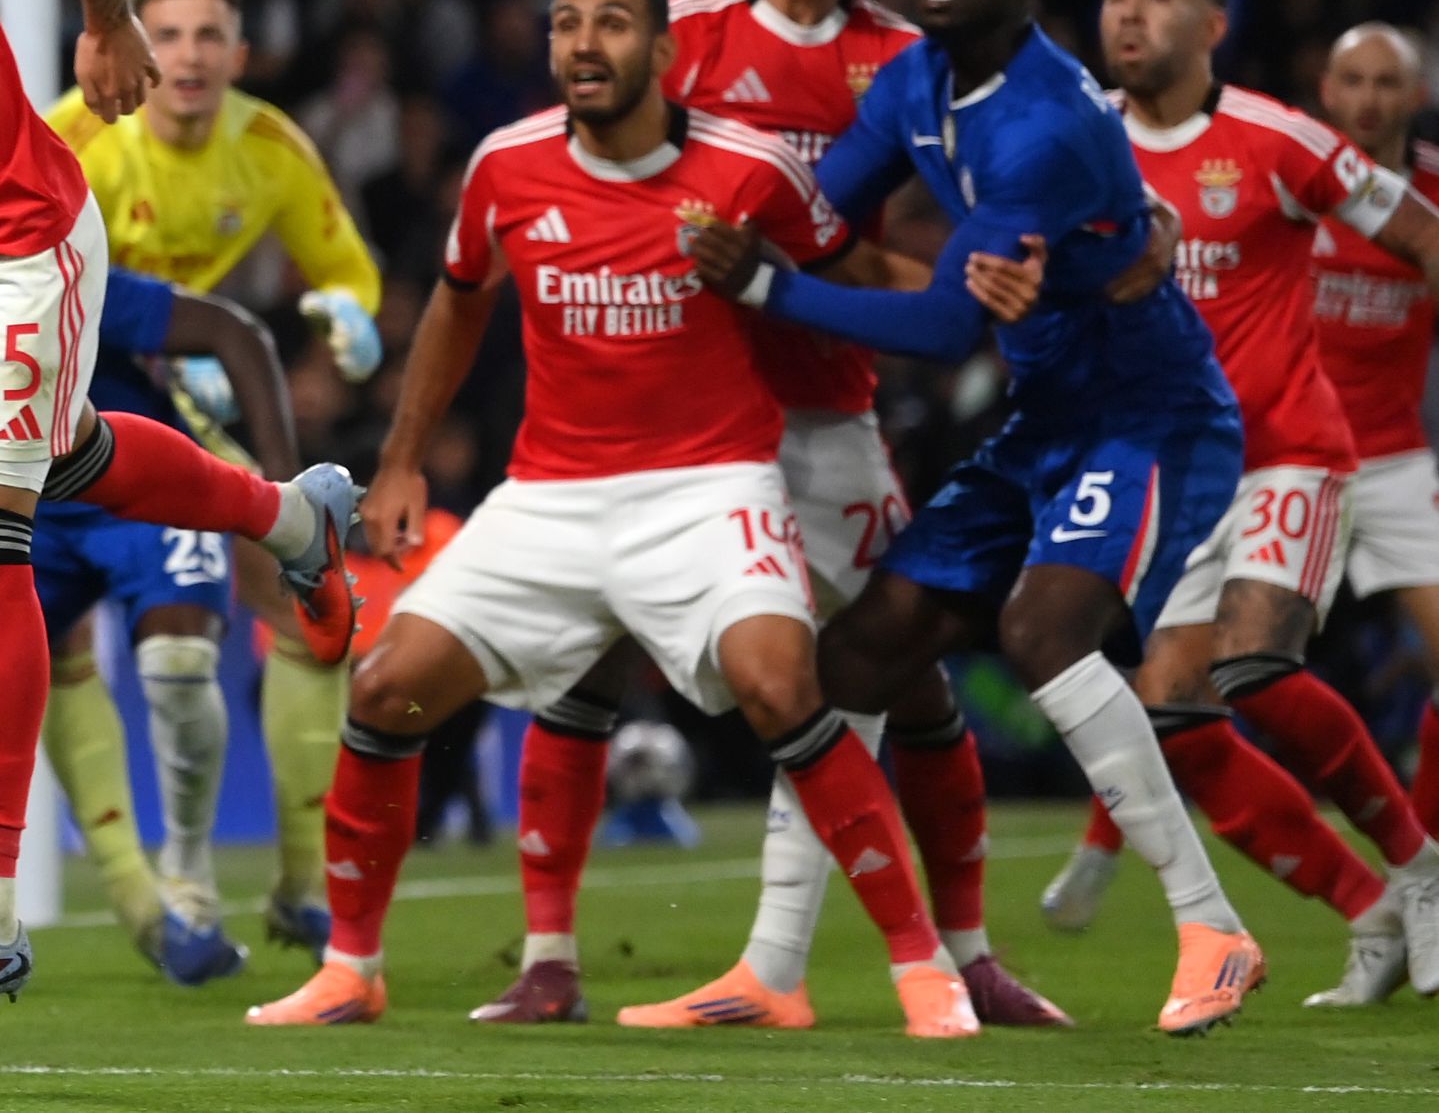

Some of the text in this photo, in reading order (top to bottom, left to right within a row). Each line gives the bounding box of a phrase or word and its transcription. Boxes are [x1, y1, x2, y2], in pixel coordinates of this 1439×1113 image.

[536, 263, 703, 305] Emirates
[563, 302, 683, 336] FLY BETTER
[3, 322, 42, 402] 5
[1069, 470, 1114, 527] 5
[1241, 489, 1310, 540] 30
[162, 527, 227, 579] 25
